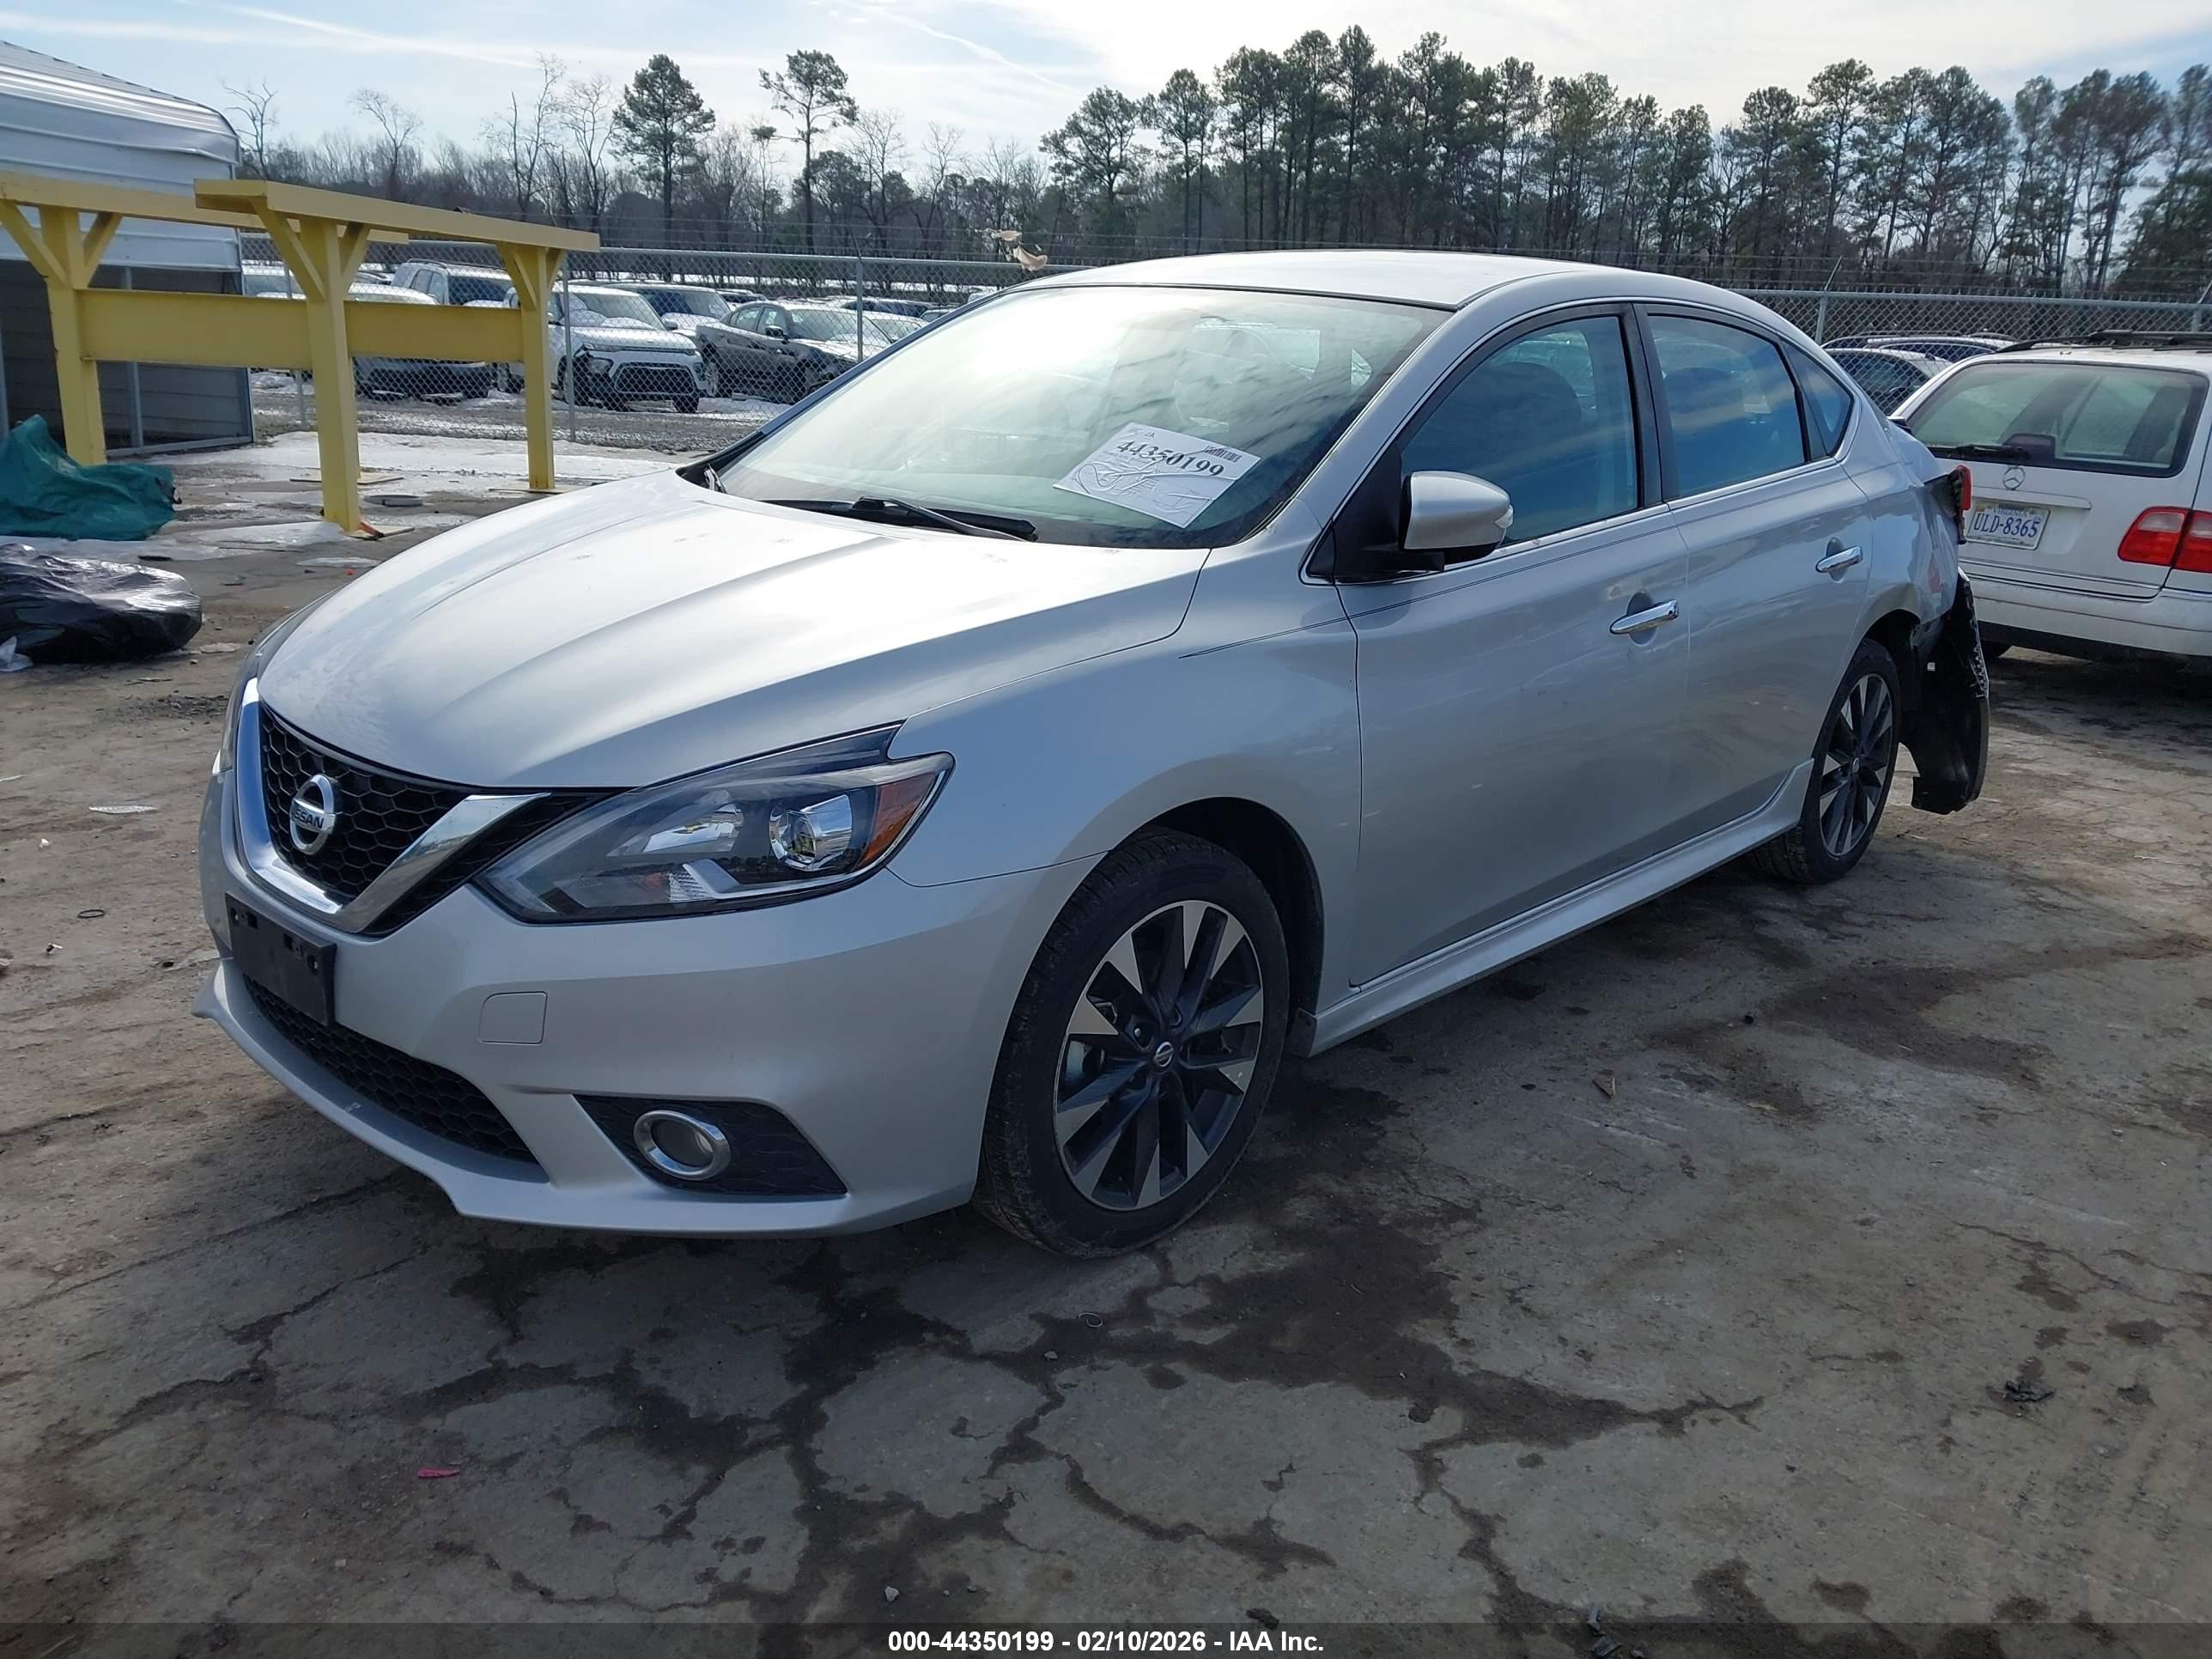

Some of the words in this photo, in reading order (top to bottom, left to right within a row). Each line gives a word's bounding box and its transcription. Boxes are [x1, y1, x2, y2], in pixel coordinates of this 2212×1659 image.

[1116, 441, 1224, 476] 44350199
[1973, 513, 2041, 538] ULD-8365
[294, 807, 324, 829] SSAN
